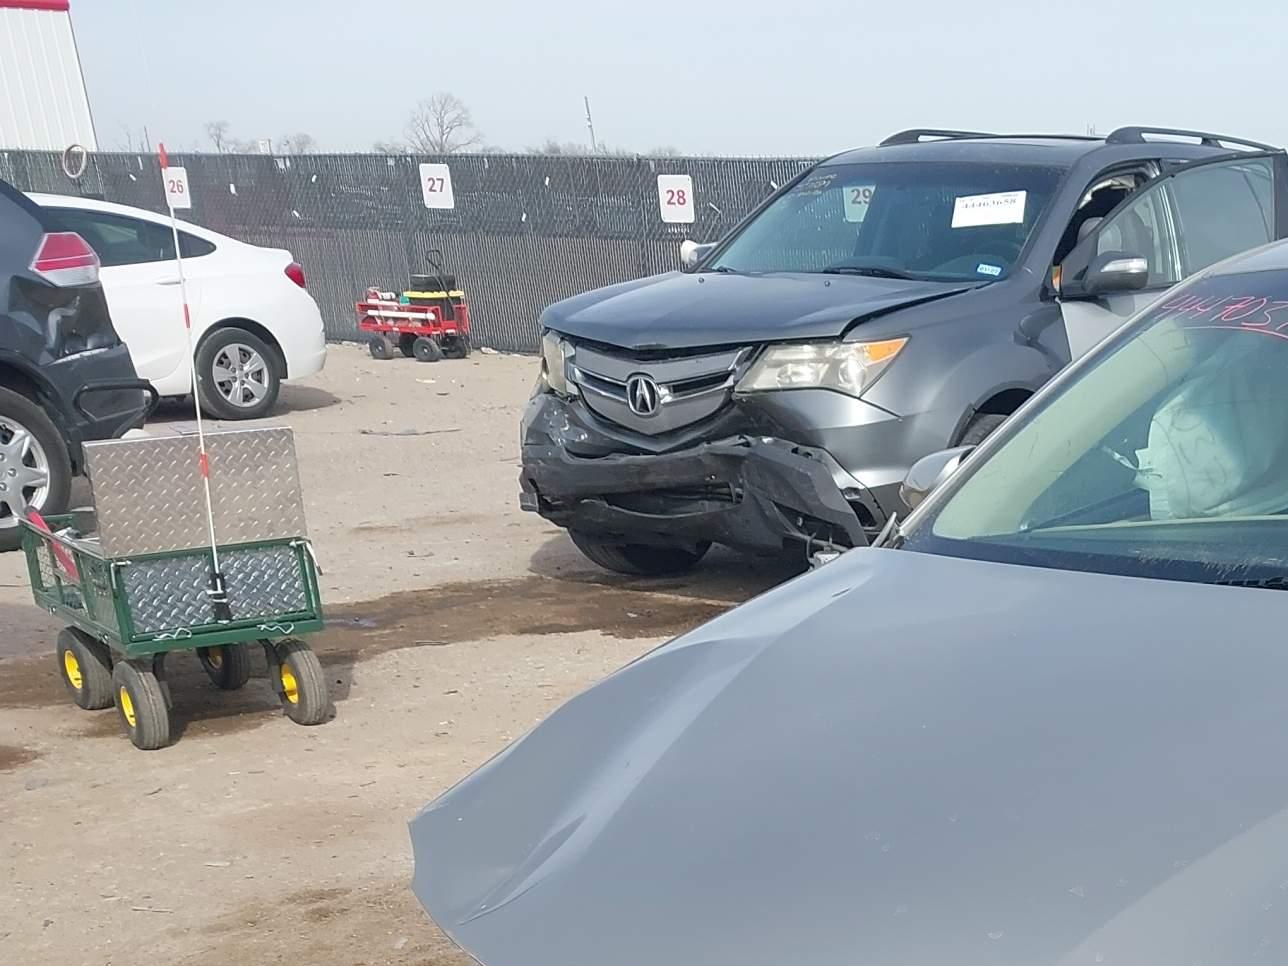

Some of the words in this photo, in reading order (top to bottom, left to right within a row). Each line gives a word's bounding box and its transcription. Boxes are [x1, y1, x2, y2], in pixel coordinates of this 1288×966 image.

[168, 179, 184, 194] 26
[427, 177, 445, 193] 27
[666, 189, 687, 206] 28
[851, 188, 872, 205] 29
